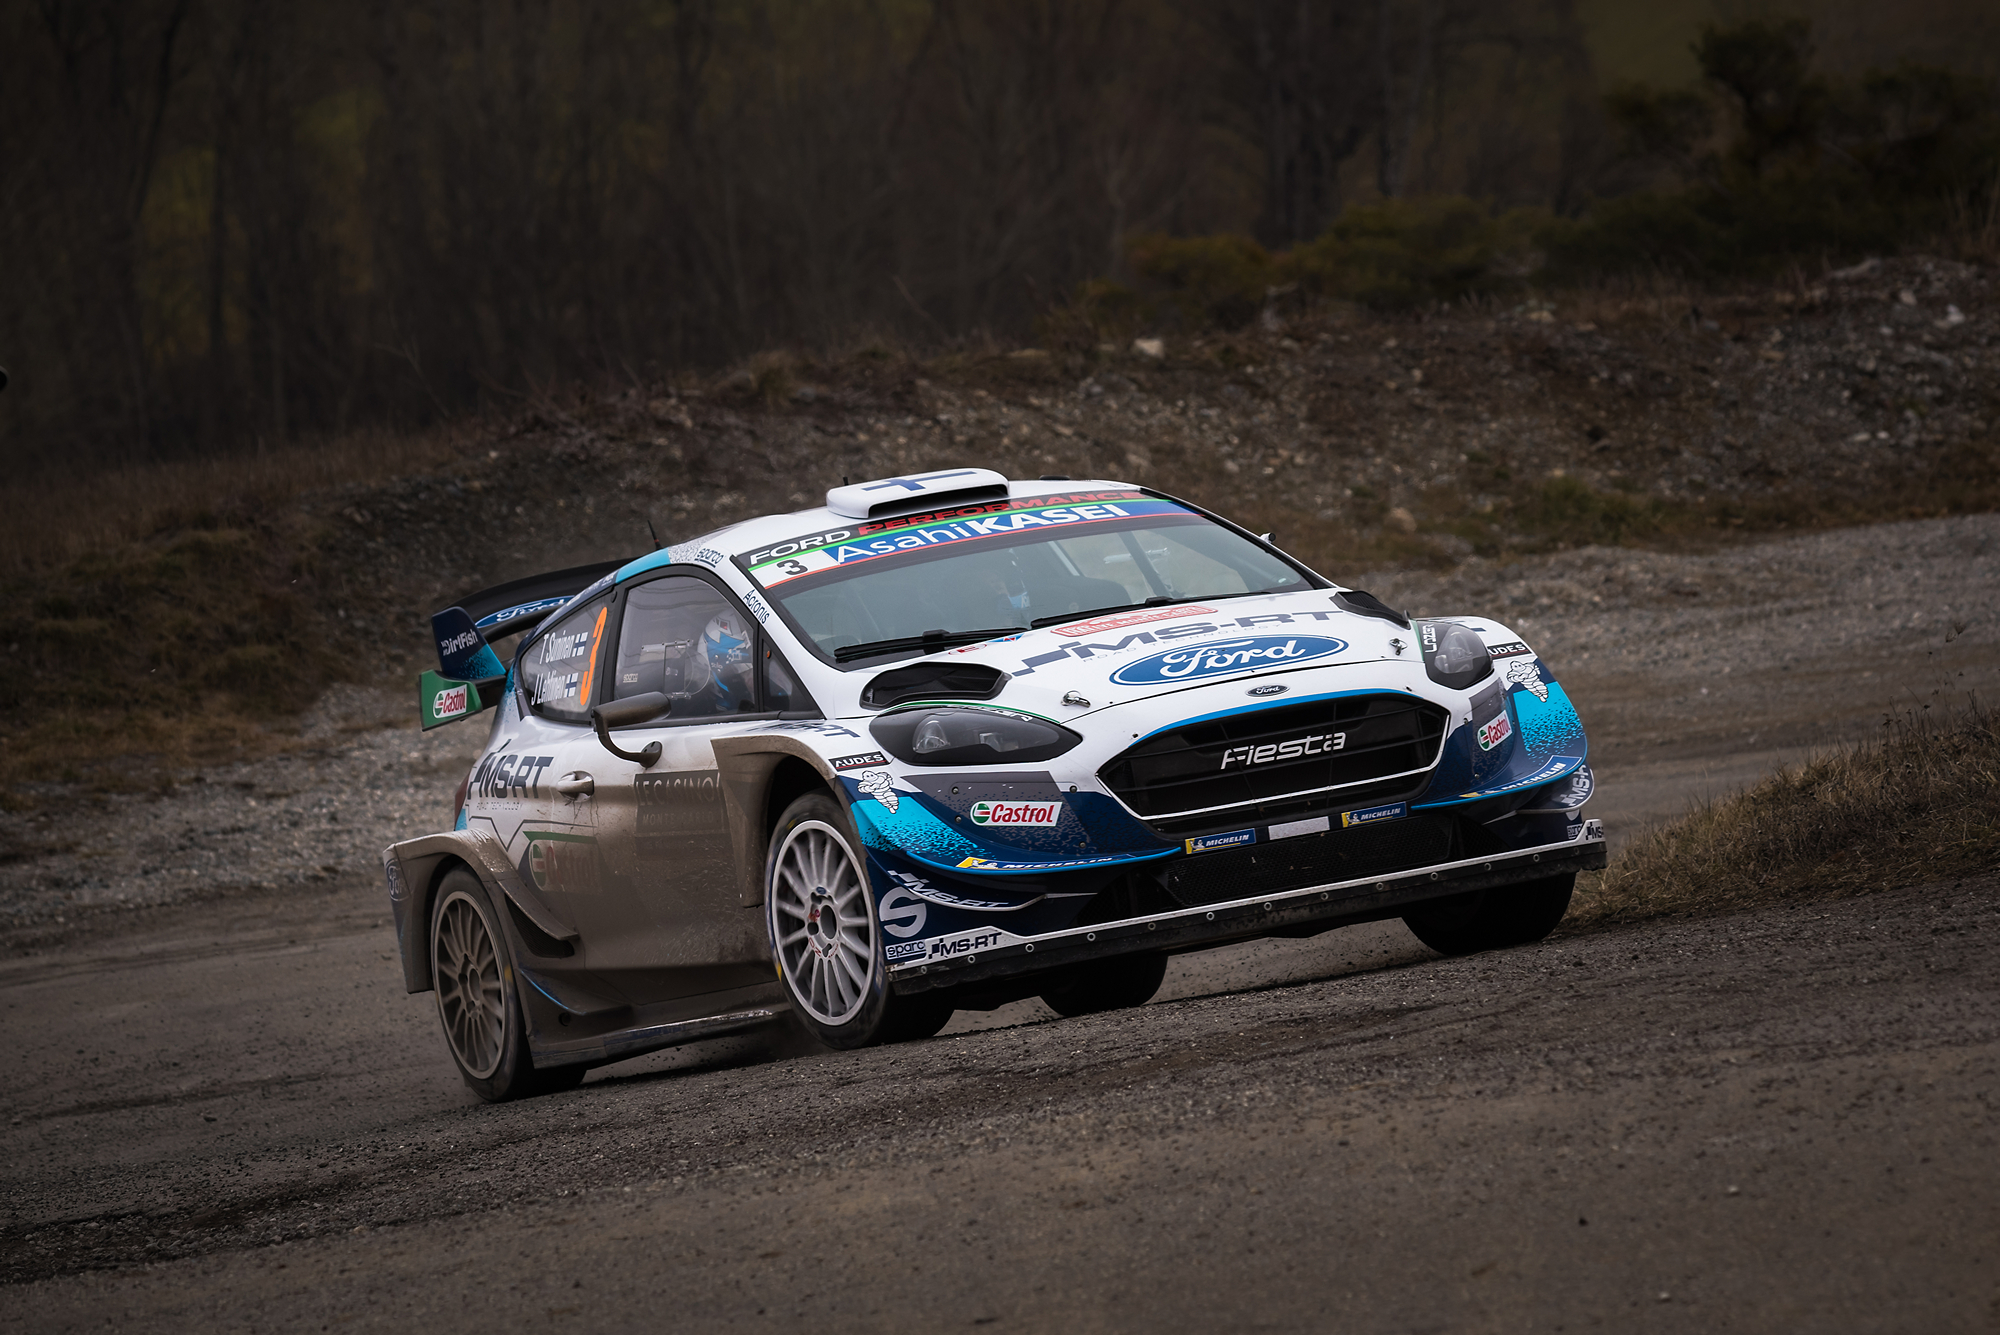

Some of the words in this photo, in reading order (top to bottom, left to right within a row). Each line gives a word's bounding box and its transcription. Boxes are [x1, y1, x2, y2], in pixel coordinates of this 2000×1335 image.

[750, 530, 851, 565] FORD
[858, 492, 1146, 535] PERFORMANCE
[696, 547, 724, 567] sparco
[776, 559, 808, 576] 3
[743, 589, 770, 624] Acronis
[441, 629, 478, 656] DirtFish
[539, 632, 550, 664] T
[1069, 611, 1343, 659] MS-RT
[580, 607, 607, 706] 3
[1160, 640, 1306, 677] Ford
[1489, 644, 1526, 656] UDES
[443, 687, 467, 714] Castrol
[531, 673, 540, 706] J
[1255, 685, 1280, 694] Ford
[1487, 714, 1511, 744] Castrol
[835, 754, 885, 767] AUDES
[1220, 732, 1346, 770] Fiesta
[1501, 763, 1567, 790] MICHELIN
[990, 803, 1053, 823] Castrol
[1361, 807, 1401, 821] MICHELIN
[1206, 834, 1249, 847] MICHELIN
[940, 932, 1002, 956] MS-RT
